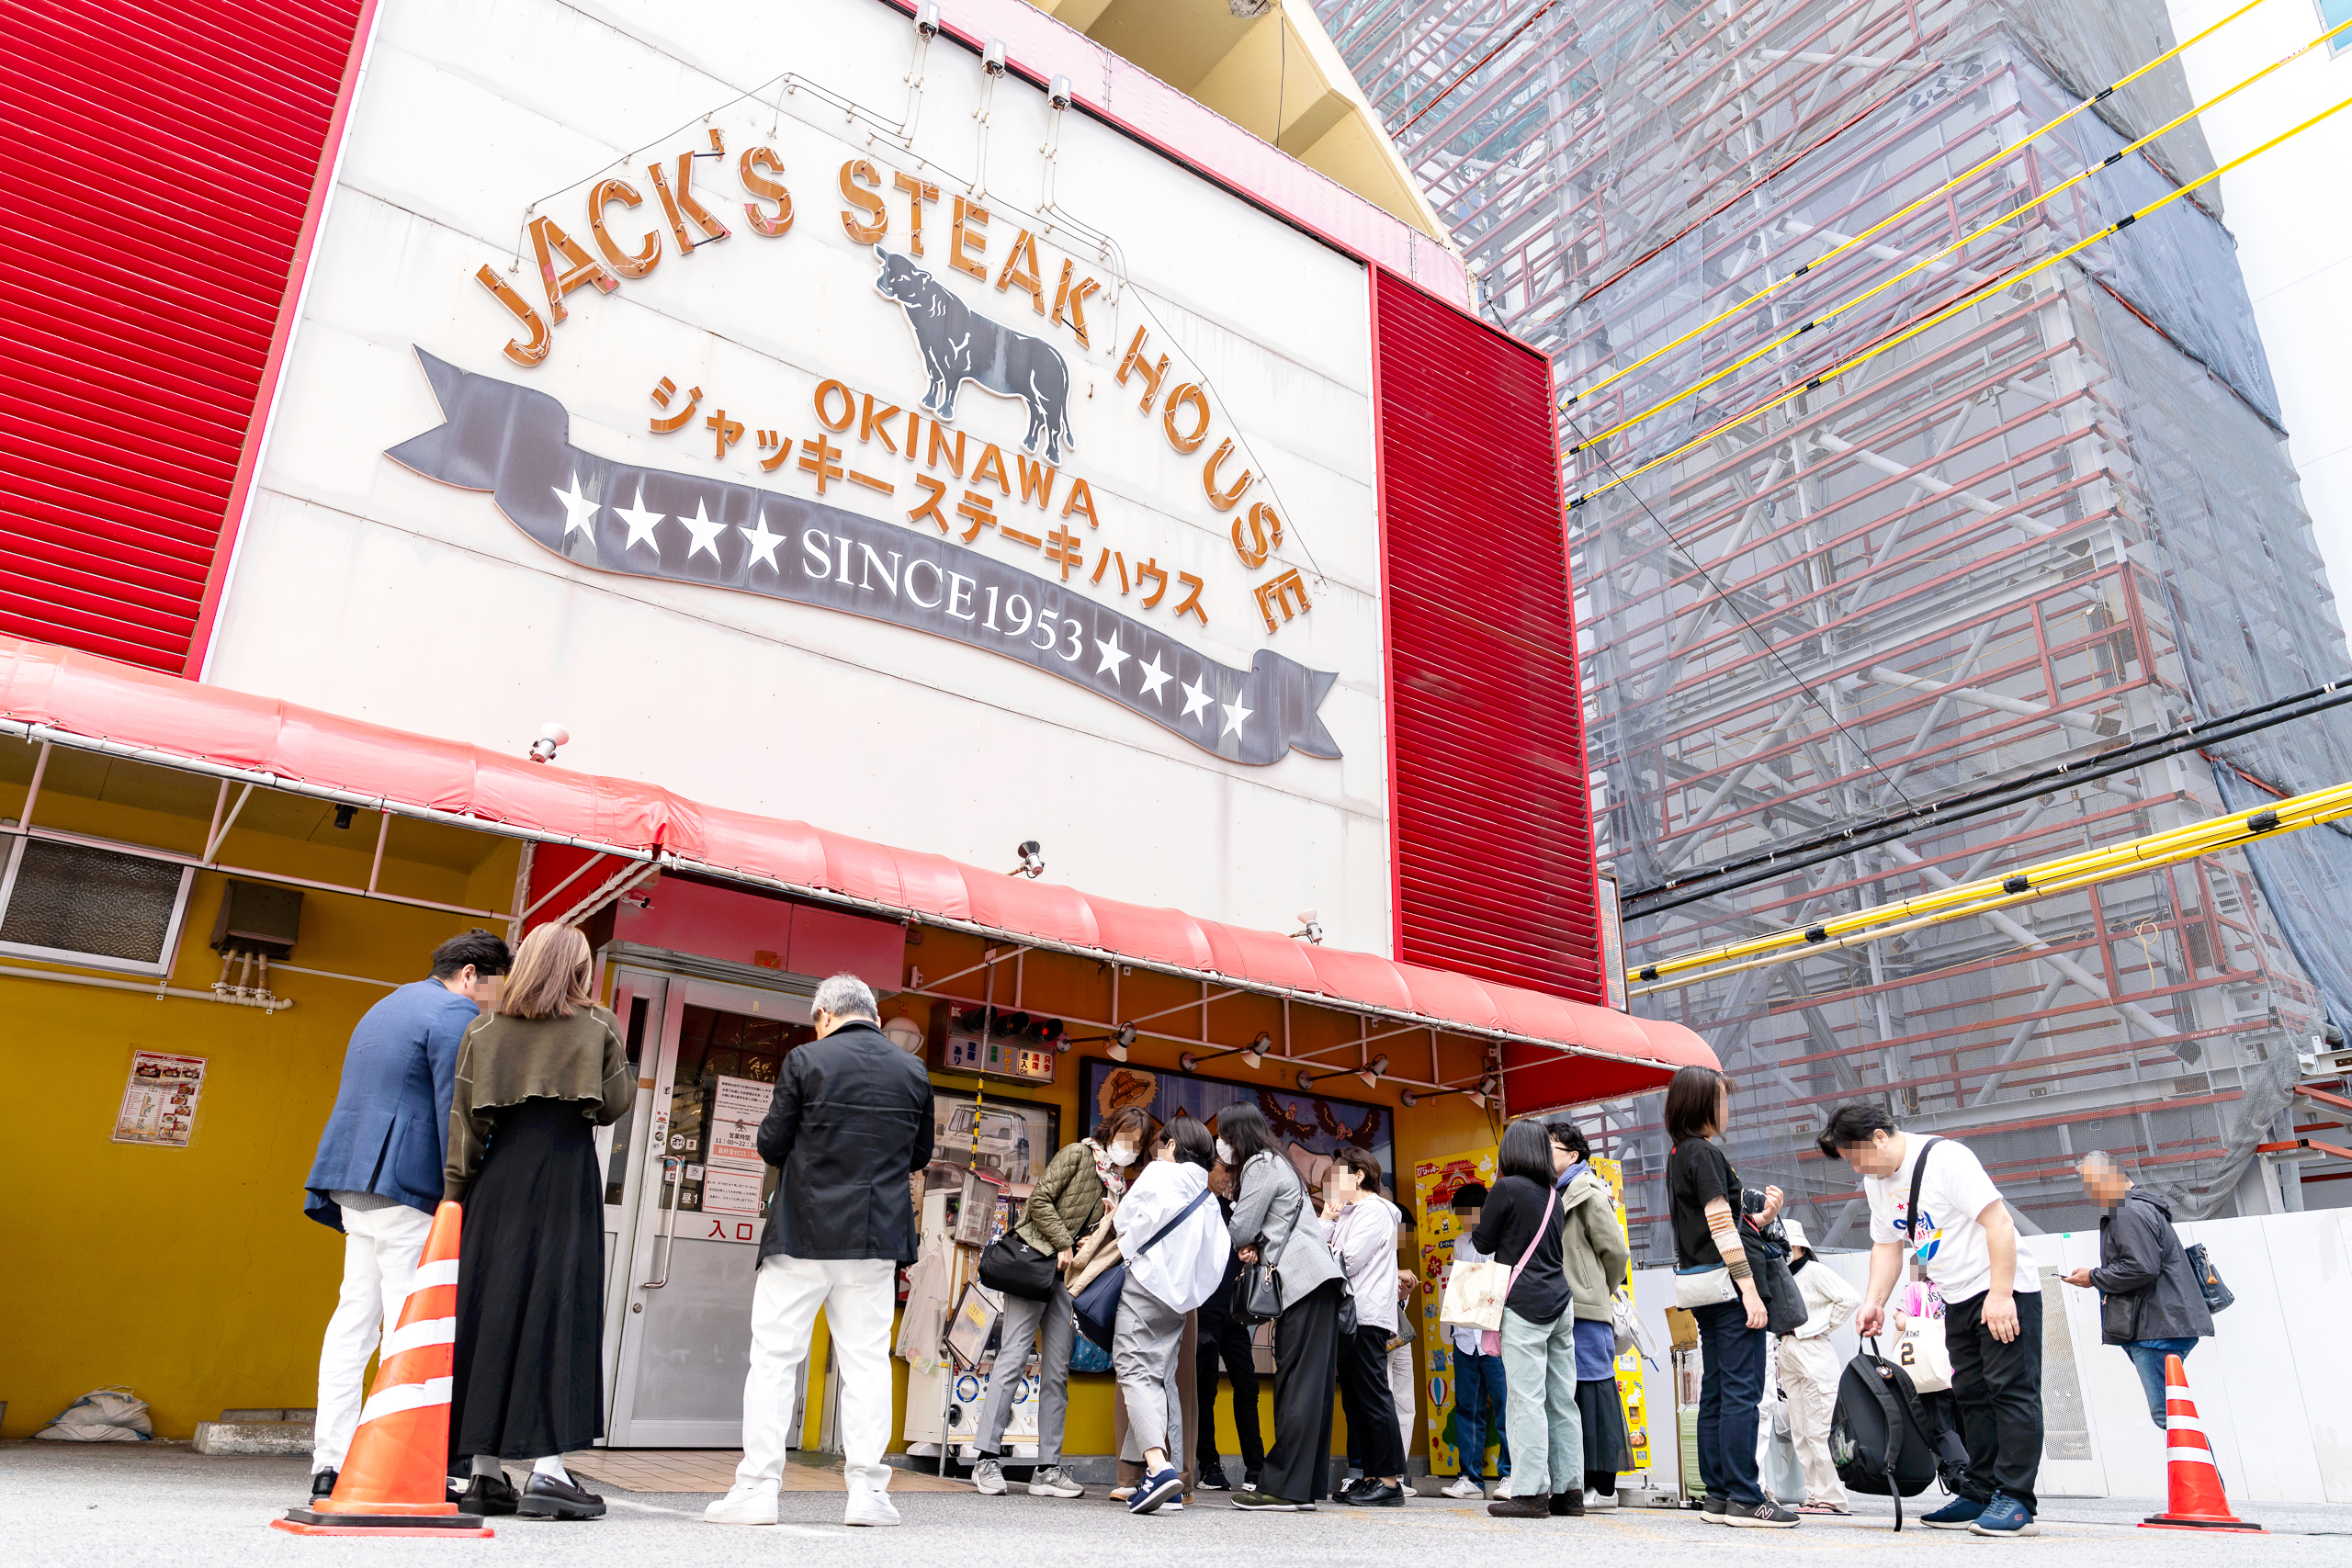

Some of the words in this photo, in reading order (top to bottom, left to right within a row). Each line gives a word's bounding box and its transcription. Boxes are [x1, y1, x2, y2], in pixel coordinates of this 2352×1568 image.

[475, 129, 795, 367] JACK'S
[838, 158, 1102, 349] STEAK
[1114, 323, 1314, 633] HOUSE
[813, 378, 1101, 528] OKINAWA
[729, 1133, 751, 1141] 営業時間
[708, 1220, 753, 1240] 入口
[1901, 1342, 1916, 1366] 2
